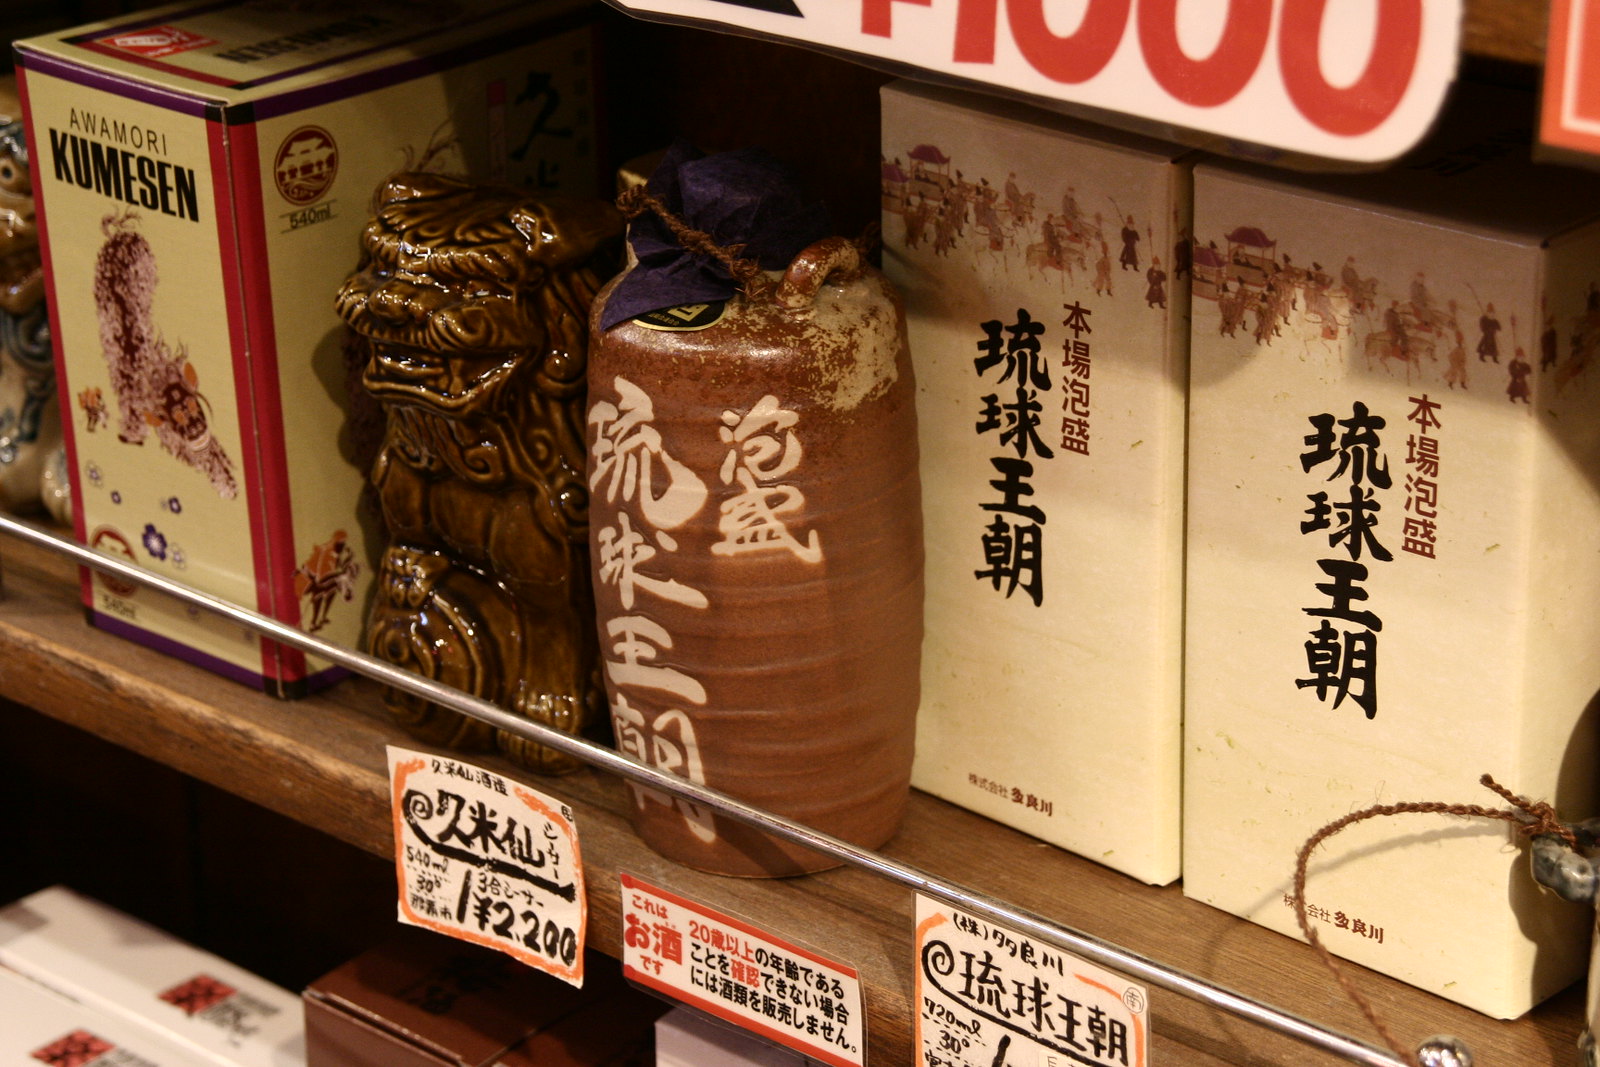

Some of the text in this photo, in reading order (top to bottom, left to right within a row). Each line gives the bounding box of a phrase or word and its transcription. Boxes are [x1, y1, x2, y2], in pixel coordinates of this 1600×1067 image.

[69, 107, 167, 156] AWAMORI
[48, 127, 200, 223] KUMESEN
[1059, 300, 1093, 457] 本場泡盛
[709, 394, 824, 564] 泡盛
[973, 307, 1055, 608] 琉球王朝
[1401, 393, 1442, 560] 本場泡盛
[1294, 400, 1394, 720] 琉球王朝
[437, 788, 546, 869] 久米仙
[624, 911, 683, 967] お酒
[631, 893, 669, 919] これは
[1283, 893, 1385, 944] 株会社多良川
[639, 952, 664, 976] です
[688, 919, 846, 1000] 20歳以上の年齢である
[690, 941, 850, 1026] ことを確認できない場合
[956, 949, 1130, 1067] 琉球王朝
